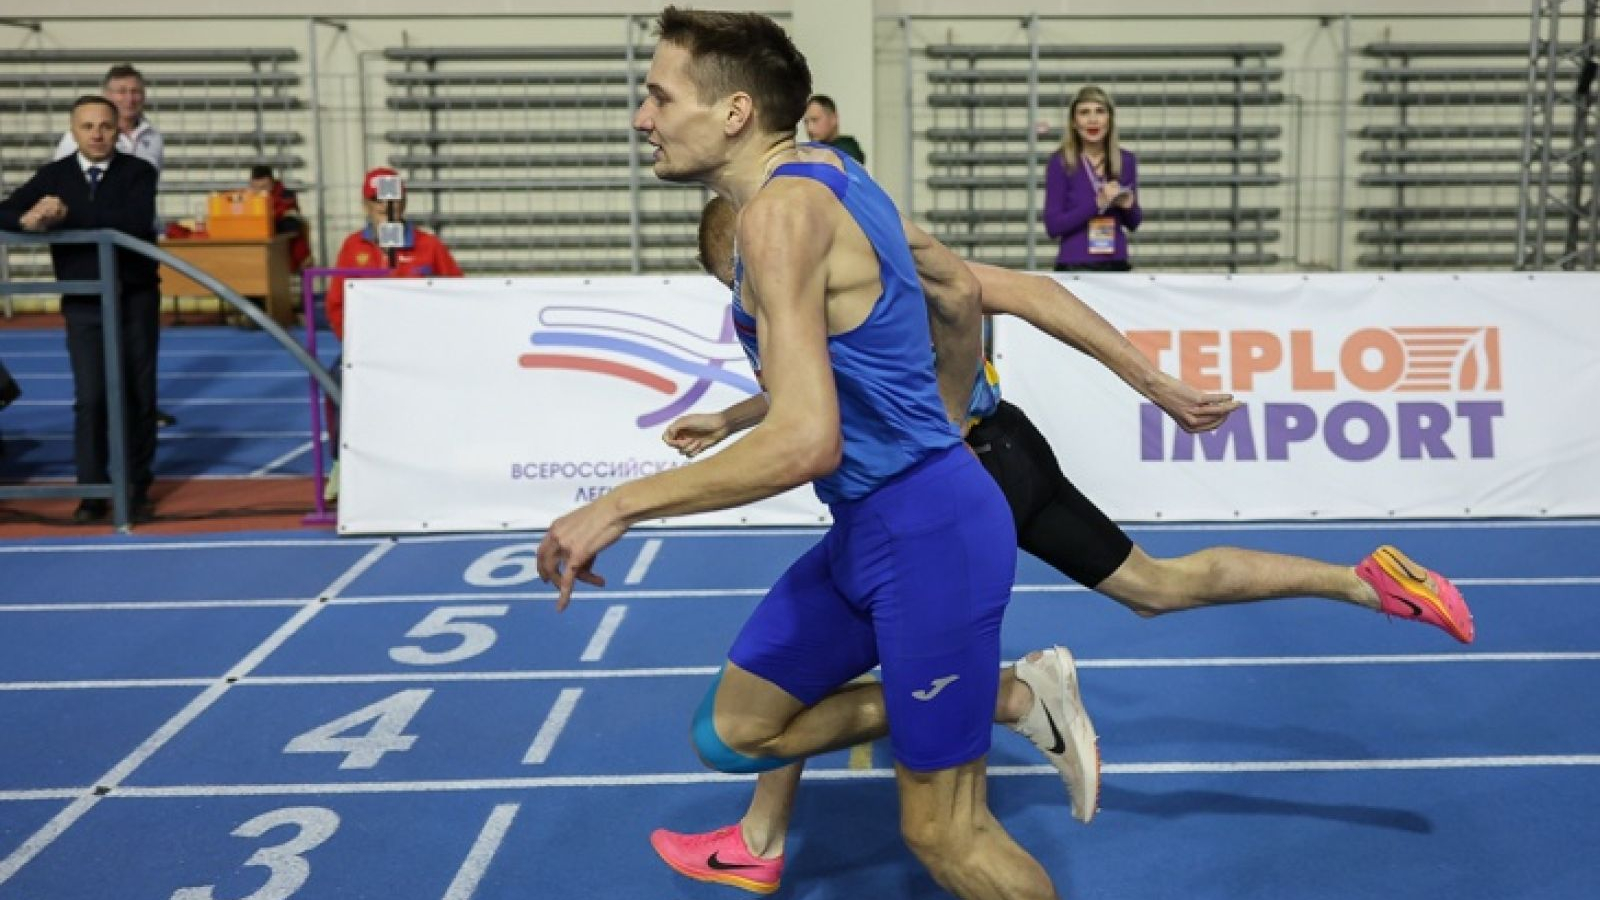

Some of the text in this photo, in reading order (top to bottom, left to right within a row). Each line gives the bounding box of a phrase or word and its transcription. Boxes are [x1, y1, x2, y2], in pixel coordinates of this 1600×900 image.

[1126, 327, 1405, 392] TEPLO
[1140, 400, 1504, 462] IMPORT
[463, 543, 539, 588] 6
[388, 605, 509, 665] 5
[283, 688, 434, 770] 4
[170, 806, 341, 900] 3
